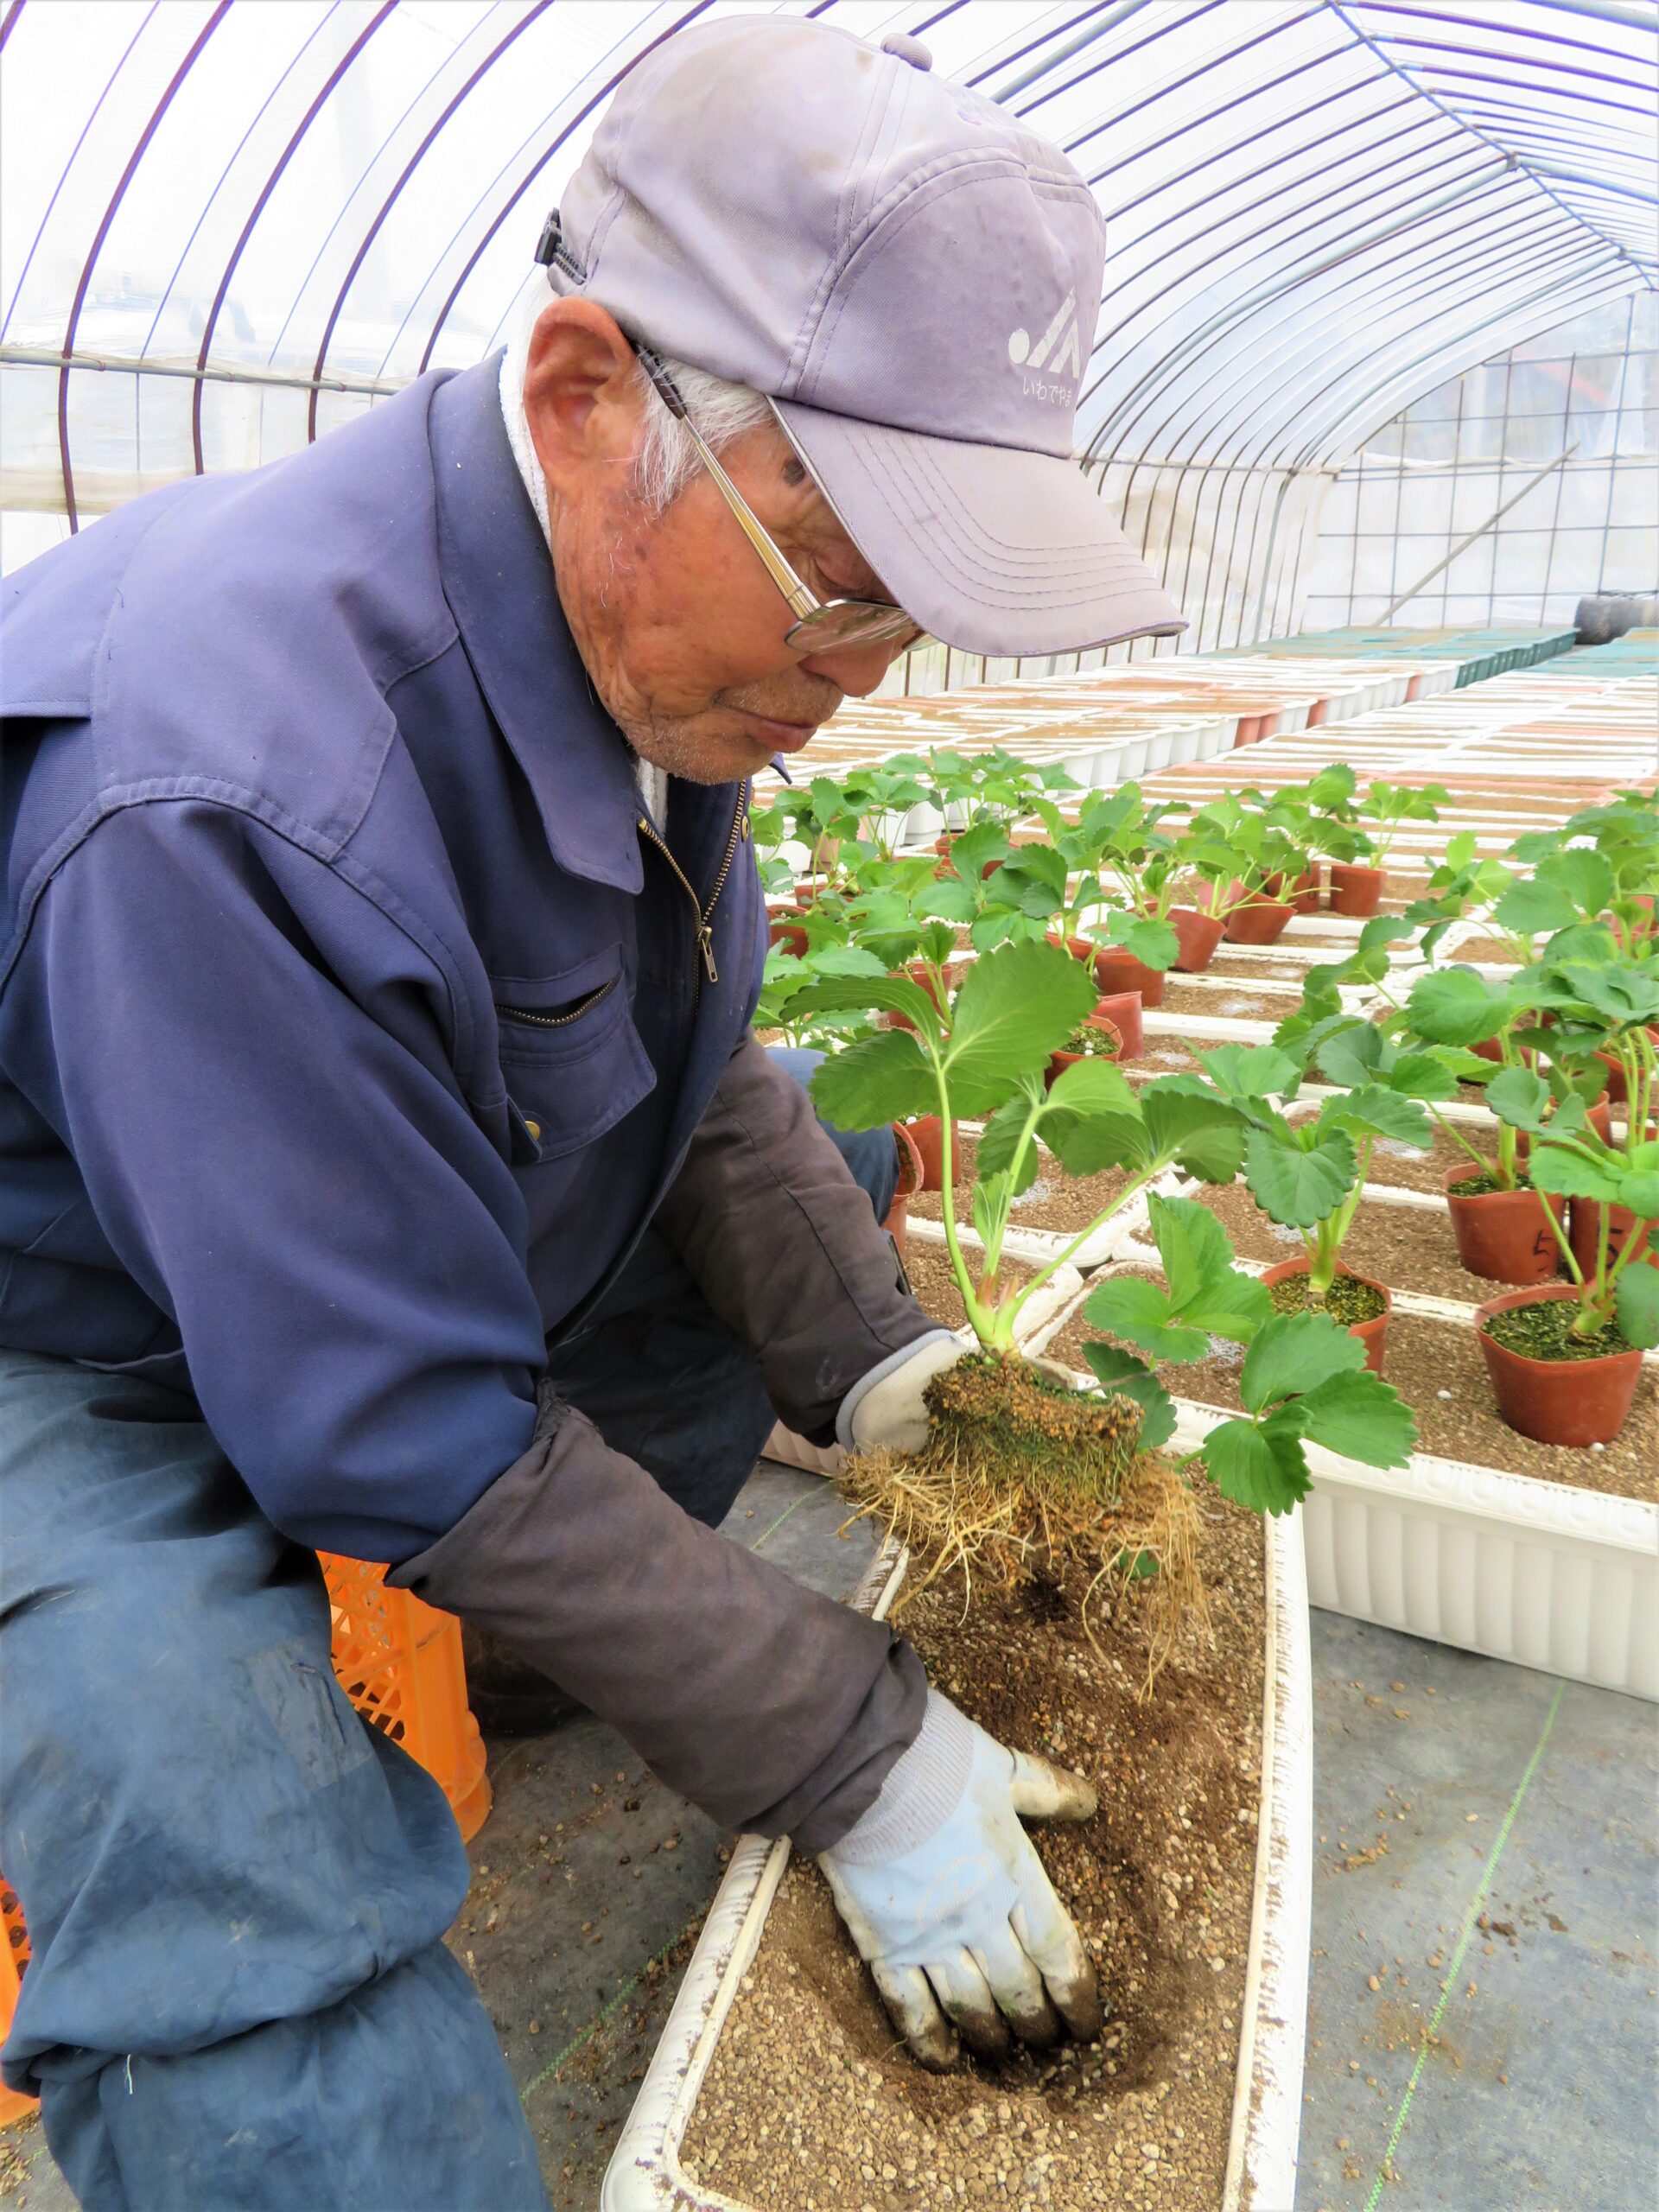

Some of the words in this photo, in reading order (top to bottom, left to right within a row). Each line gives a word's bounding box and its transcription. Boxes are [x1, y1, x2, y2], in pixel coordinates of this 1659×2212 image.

[1023, 377, 1072, 407] いわでやま
